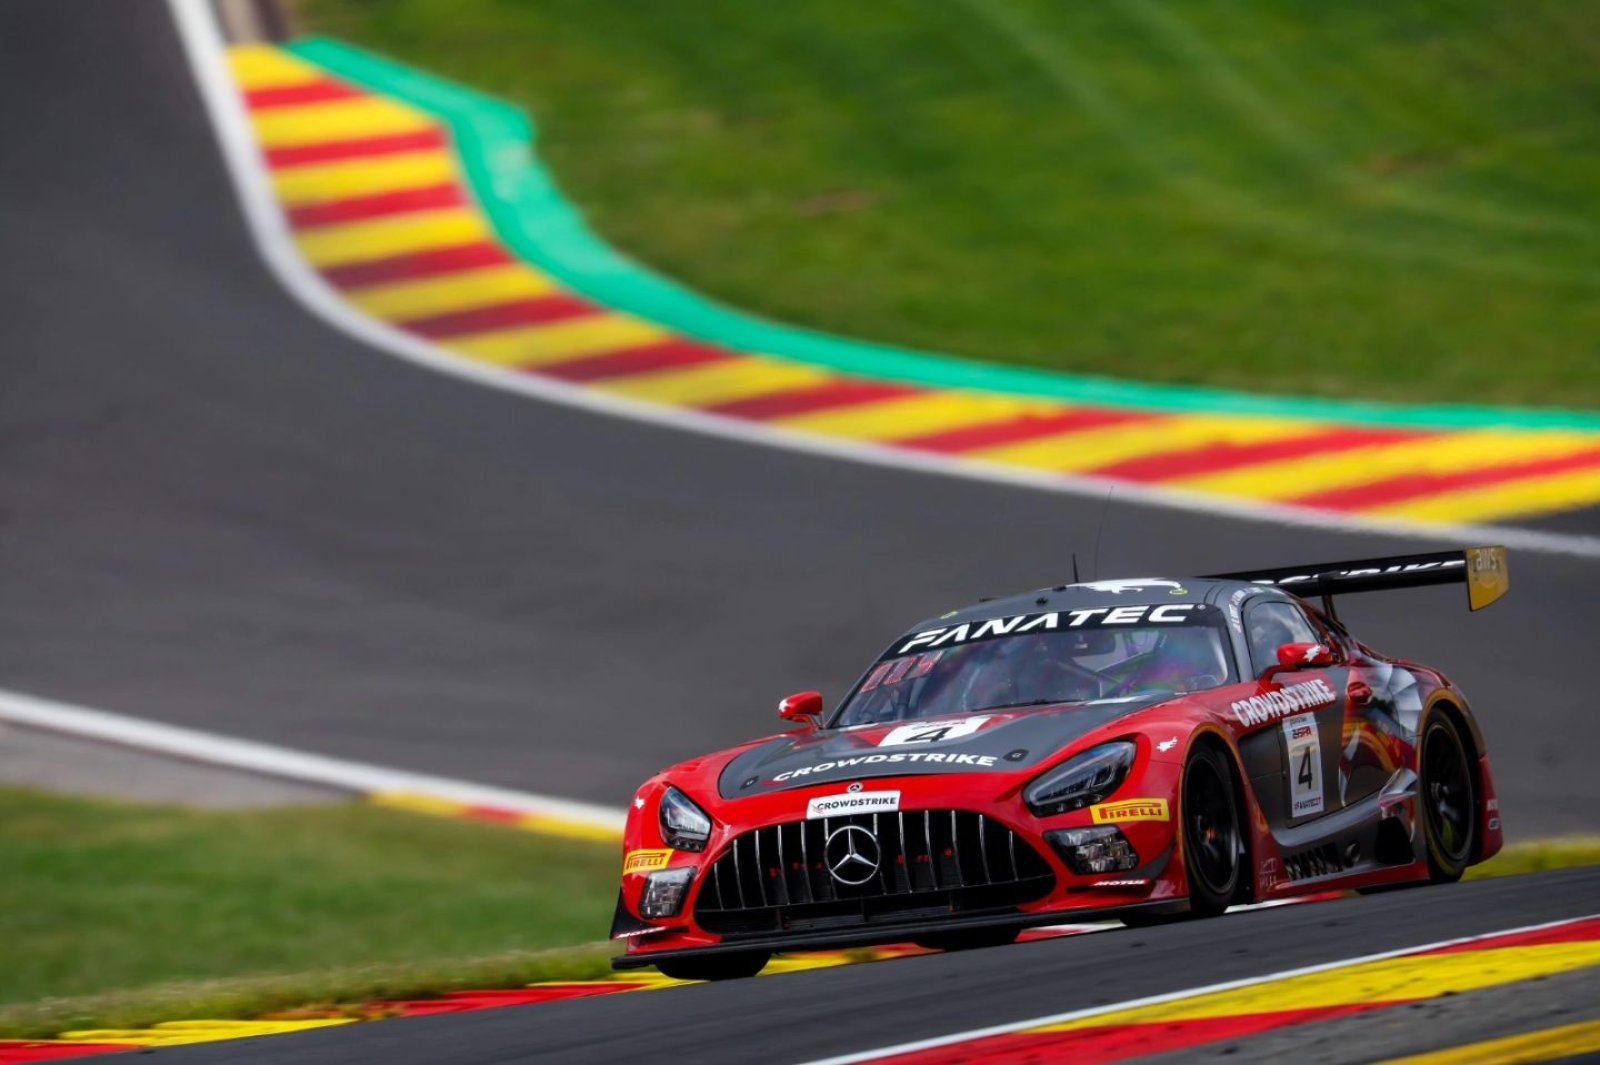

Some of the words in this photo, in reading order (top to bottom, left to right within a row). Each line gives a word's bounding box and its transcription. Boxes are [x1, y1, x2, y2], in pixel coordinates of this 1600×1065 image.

[897, 604, 1194, 654] FANATEC
[1231, 678, 1336, 727] CROWDSTRIKE
[902, 727, 953, 743] 4
[773, 753, 998, 781] CROWDSTRIKE
[1298, 746, 1312, 790] 4
[817, 797, 897, 810] CROWDSTRIKE
[1099, 802, 1162, 820] PIRELLI
[626, 853, 667, 870] PIRELLI
